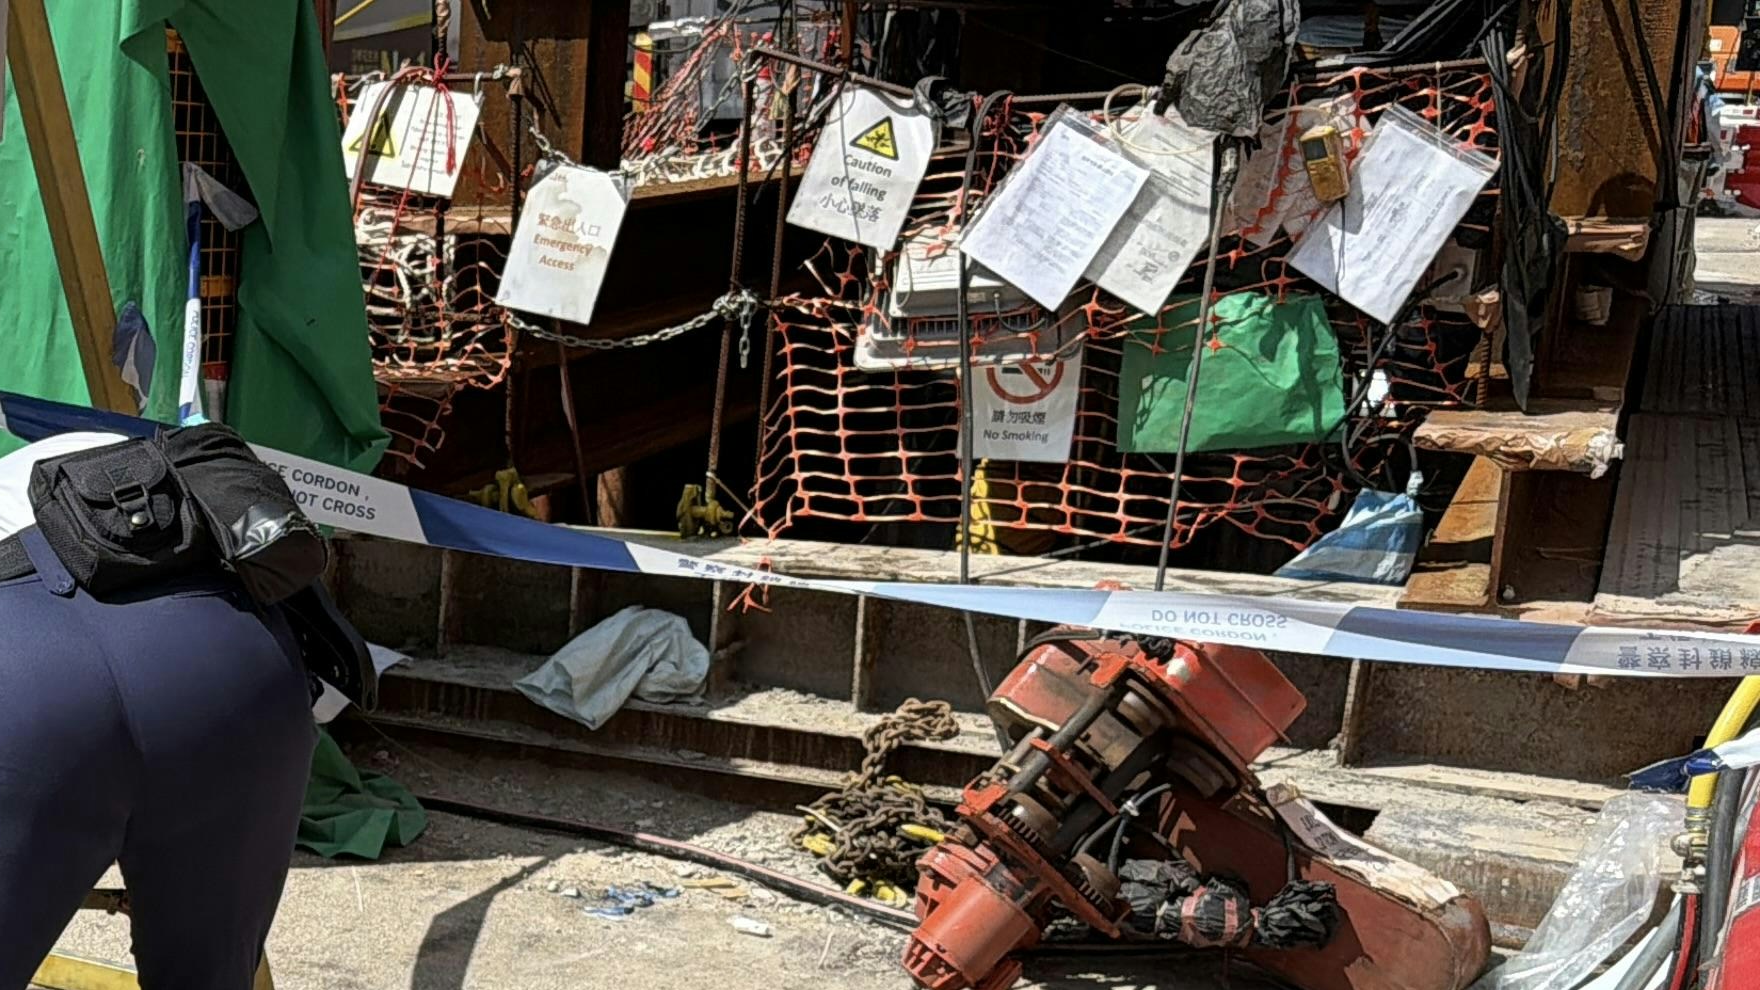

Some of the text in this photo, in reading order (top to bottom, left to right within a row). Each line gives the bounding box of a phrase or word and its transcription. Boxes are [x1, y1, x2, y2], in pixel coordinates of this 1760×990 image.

[844, 154, 892, 178] Caution
[831, 175, 887, 201] of falling
[533, 234, 593, 256] Emergency
[539, 255, 576, 271] Access
[983, 429, 1048, 444] No Smoking
[322, 497, 376, 520] CROSS
